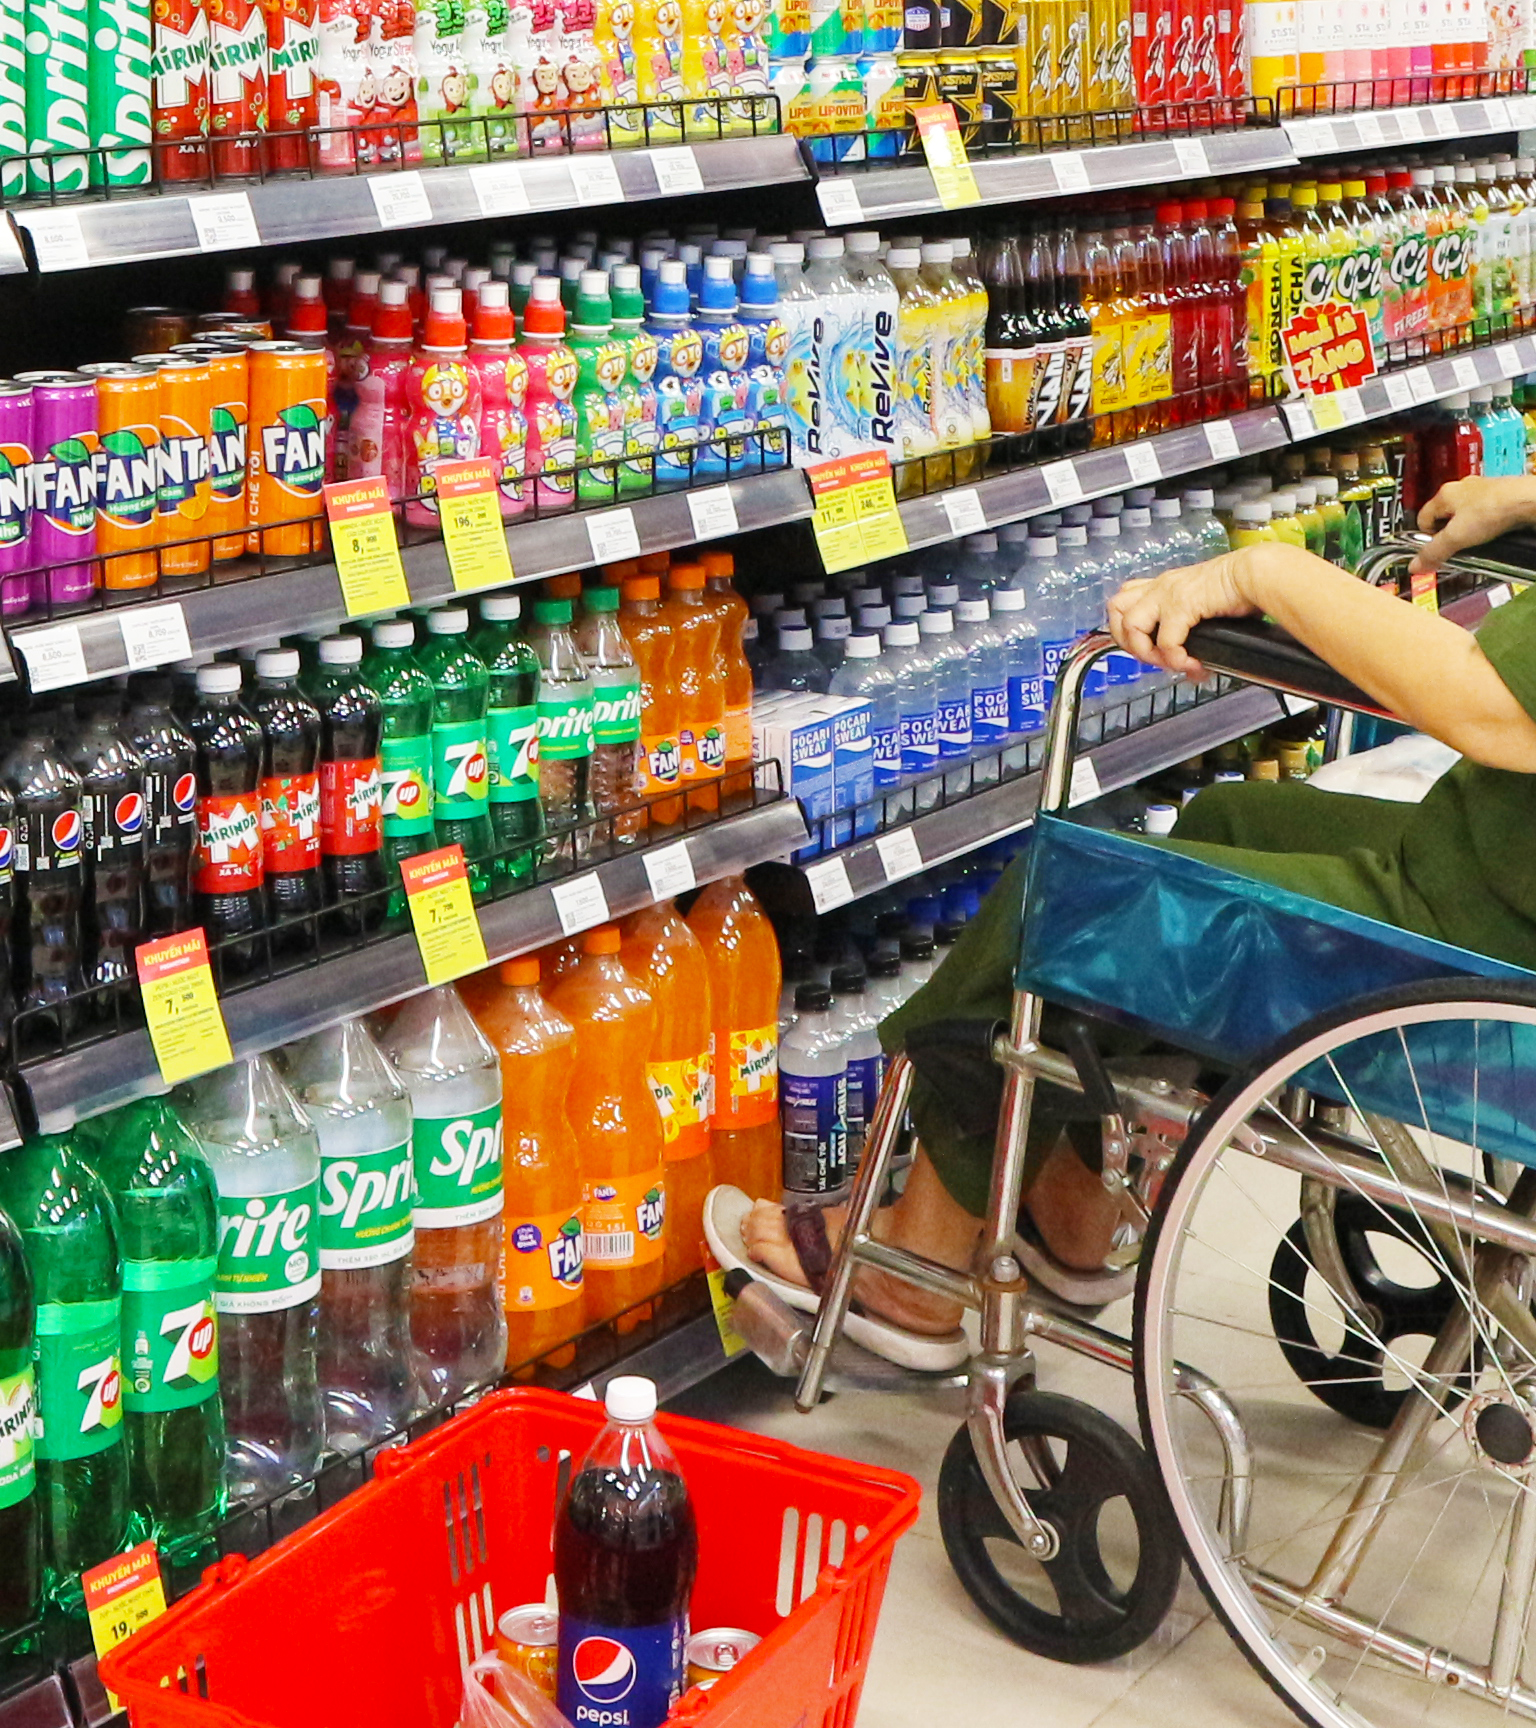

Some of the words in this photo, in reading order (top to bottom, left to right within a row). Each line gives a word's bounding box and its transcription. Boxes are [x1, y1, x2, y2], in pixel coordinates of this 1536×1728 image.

[538, 699, 593, 739] prite
[833, 711, 871, 733] POCARI
[791, 727, 831, 750] POCARI
[834, 724, 868, 748] SWEAT
[792, 742, 828, 763] SWEAT
[216, 1198, 311, 1258] rite
[576, 1702, 630, 1728] pepsi
